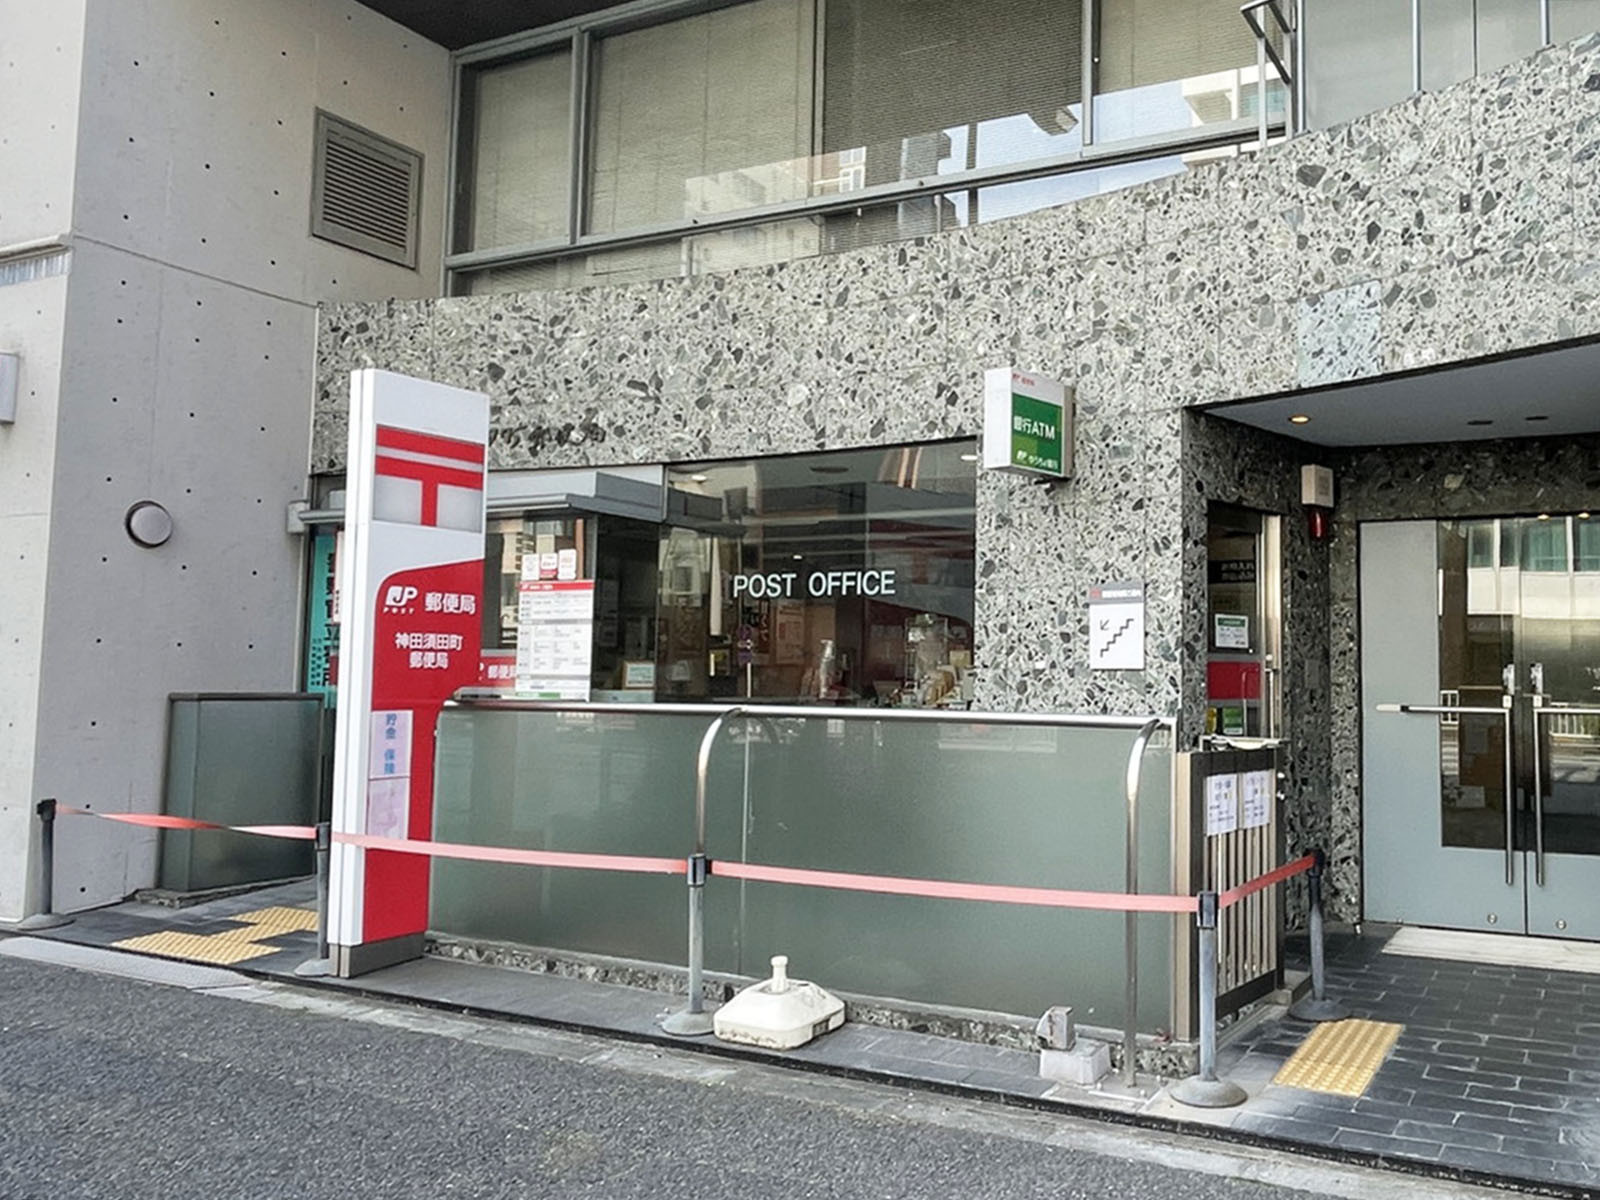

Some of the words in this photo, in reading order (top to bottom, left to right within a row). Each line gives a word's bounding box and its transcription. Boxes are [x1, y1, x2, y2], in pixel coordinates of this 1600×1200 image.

[733, 572, 797, 598] POST
[808, 570, 896, 597] OFFICE
[424, 591, 476, 615] 郵便局
[395, 631, 463, 652] 神田須田町
[409, 650, 449, 669] 郵便局
